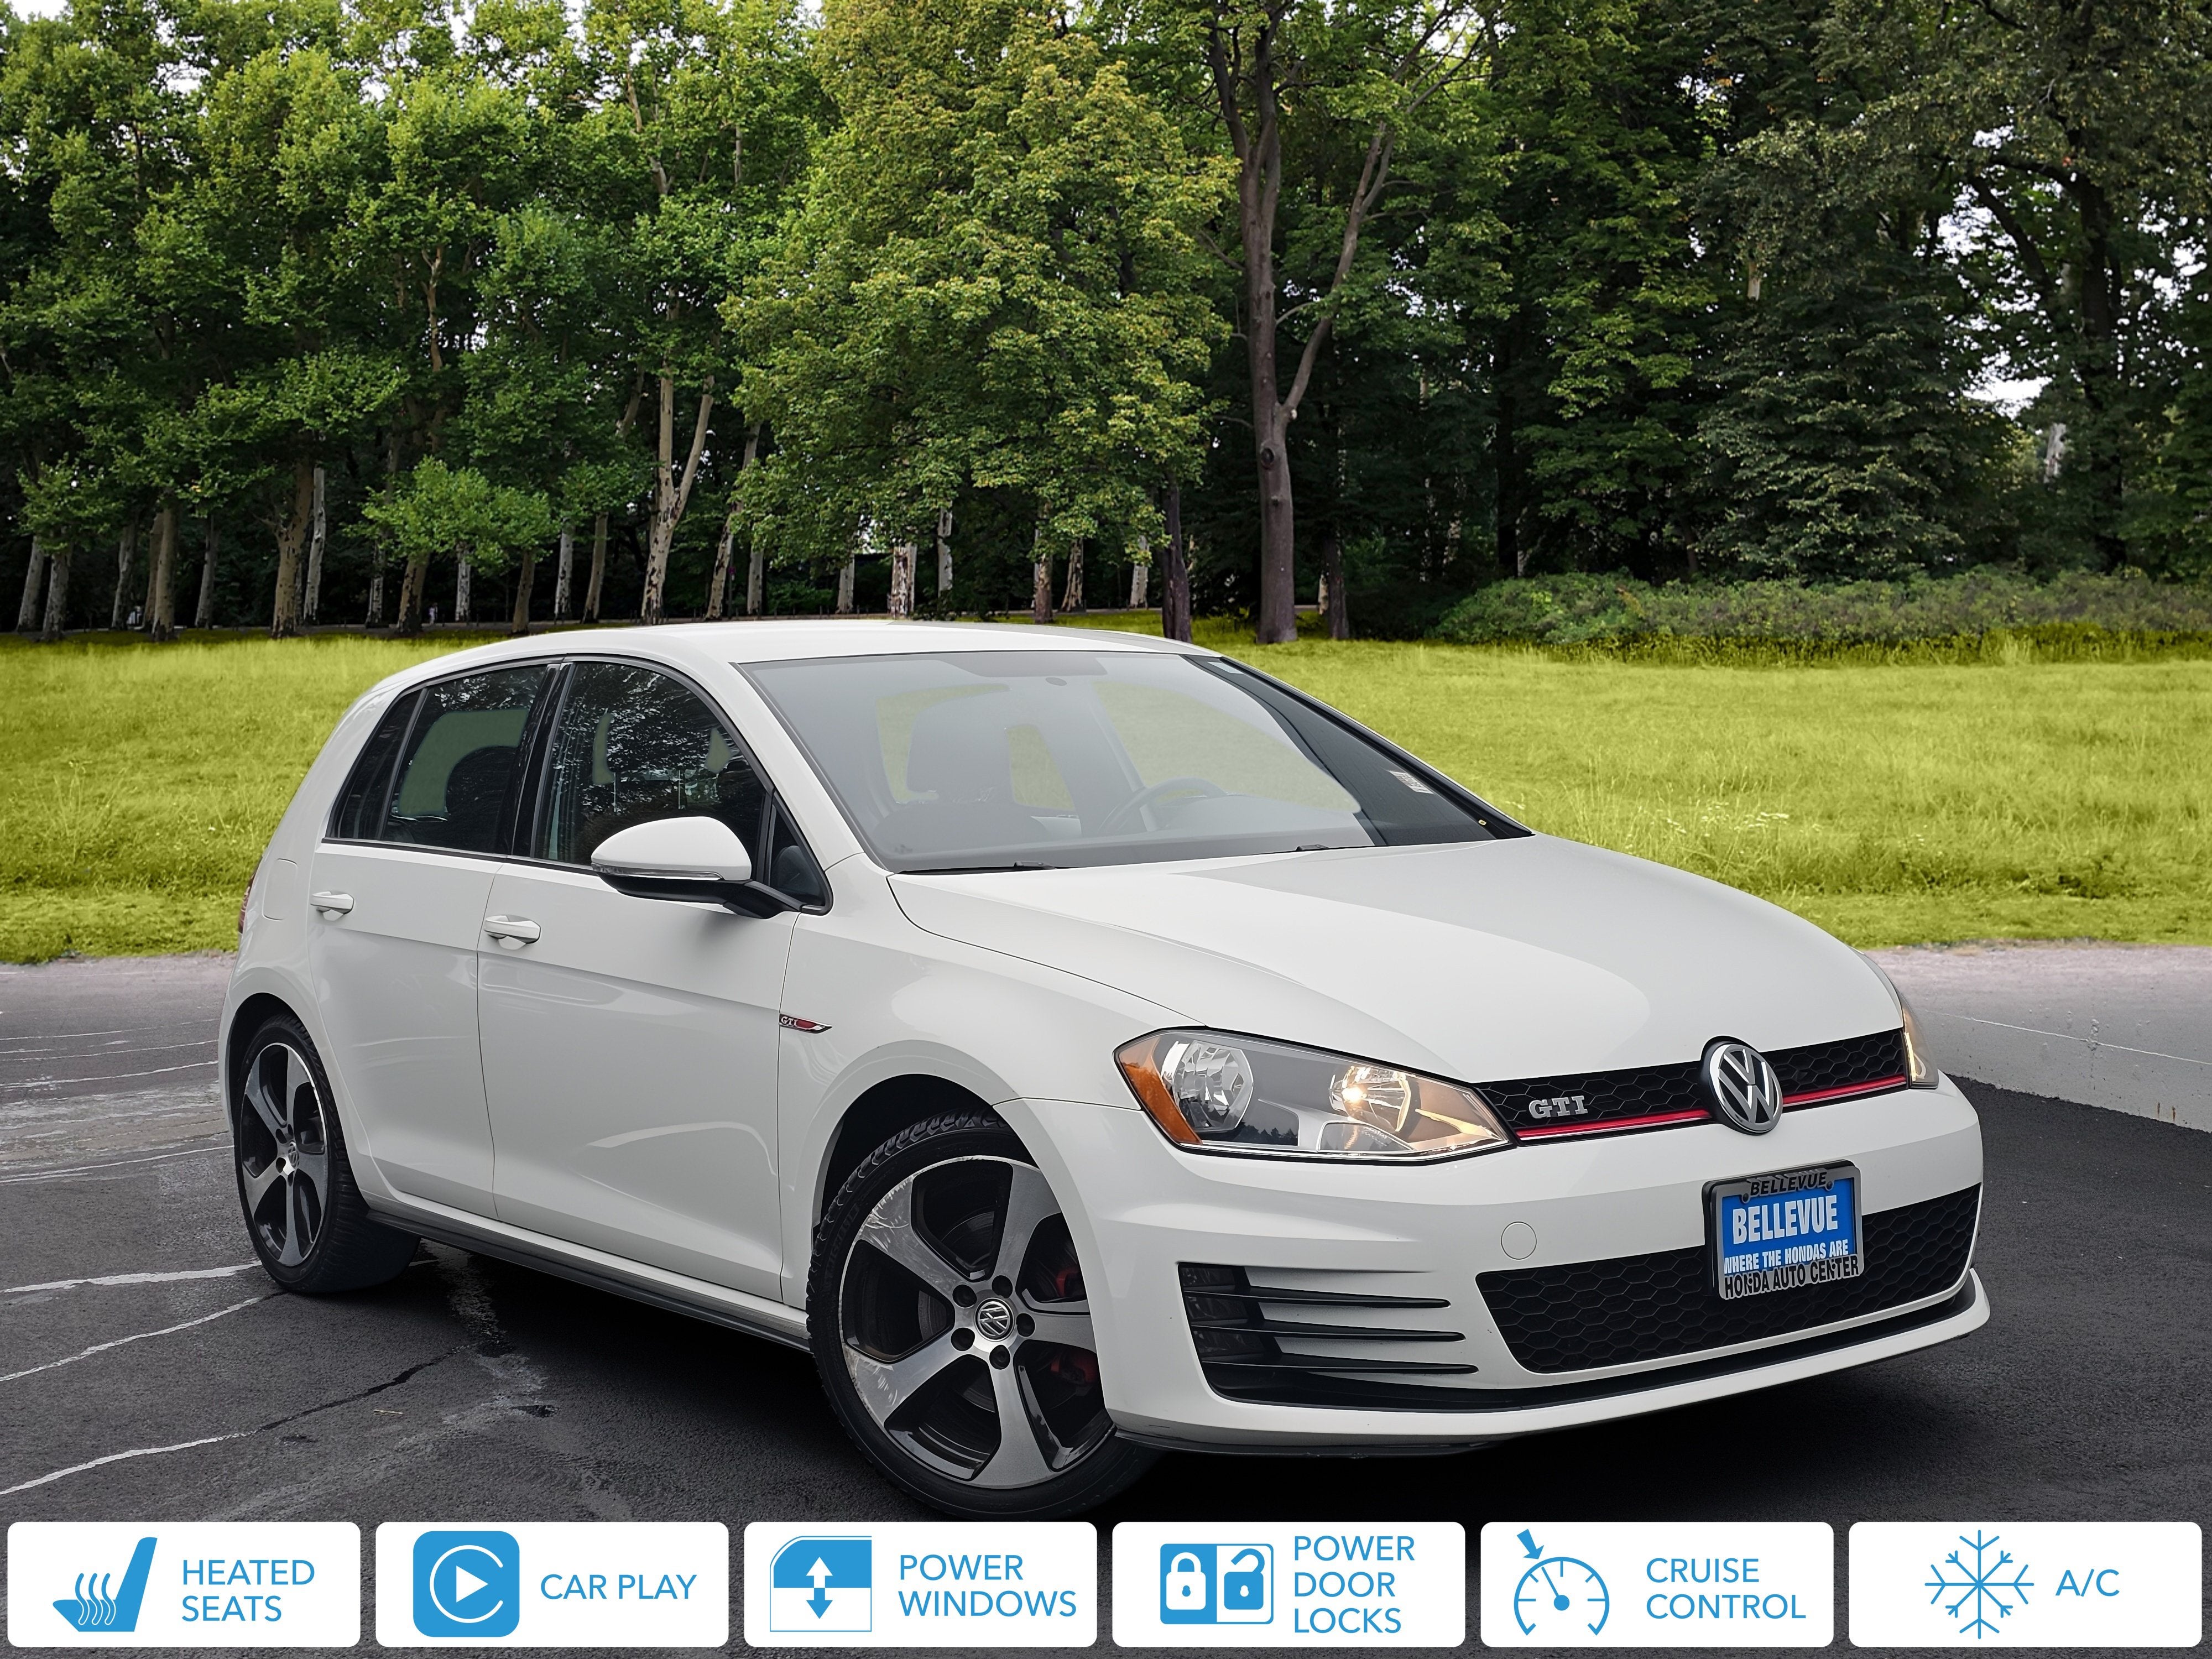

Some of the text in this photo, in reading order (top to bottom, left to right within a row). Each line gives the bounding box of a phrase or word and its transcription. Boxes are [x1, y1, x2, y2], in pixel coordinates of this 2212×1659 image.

[780, 1016, 799, 1027] GTI
[1528, 1095, 1589, 1119] GTI
[1750, 1171, 1828, 1196] BELLEVUE
[1733, 1194, 1838, 1245] BELLEVUE
[1724, 1239, 1849, 1275] WHERE THE HONDAS ARE
[1724, 1255, 1859, 1298] HONDA AUTO CENTER
